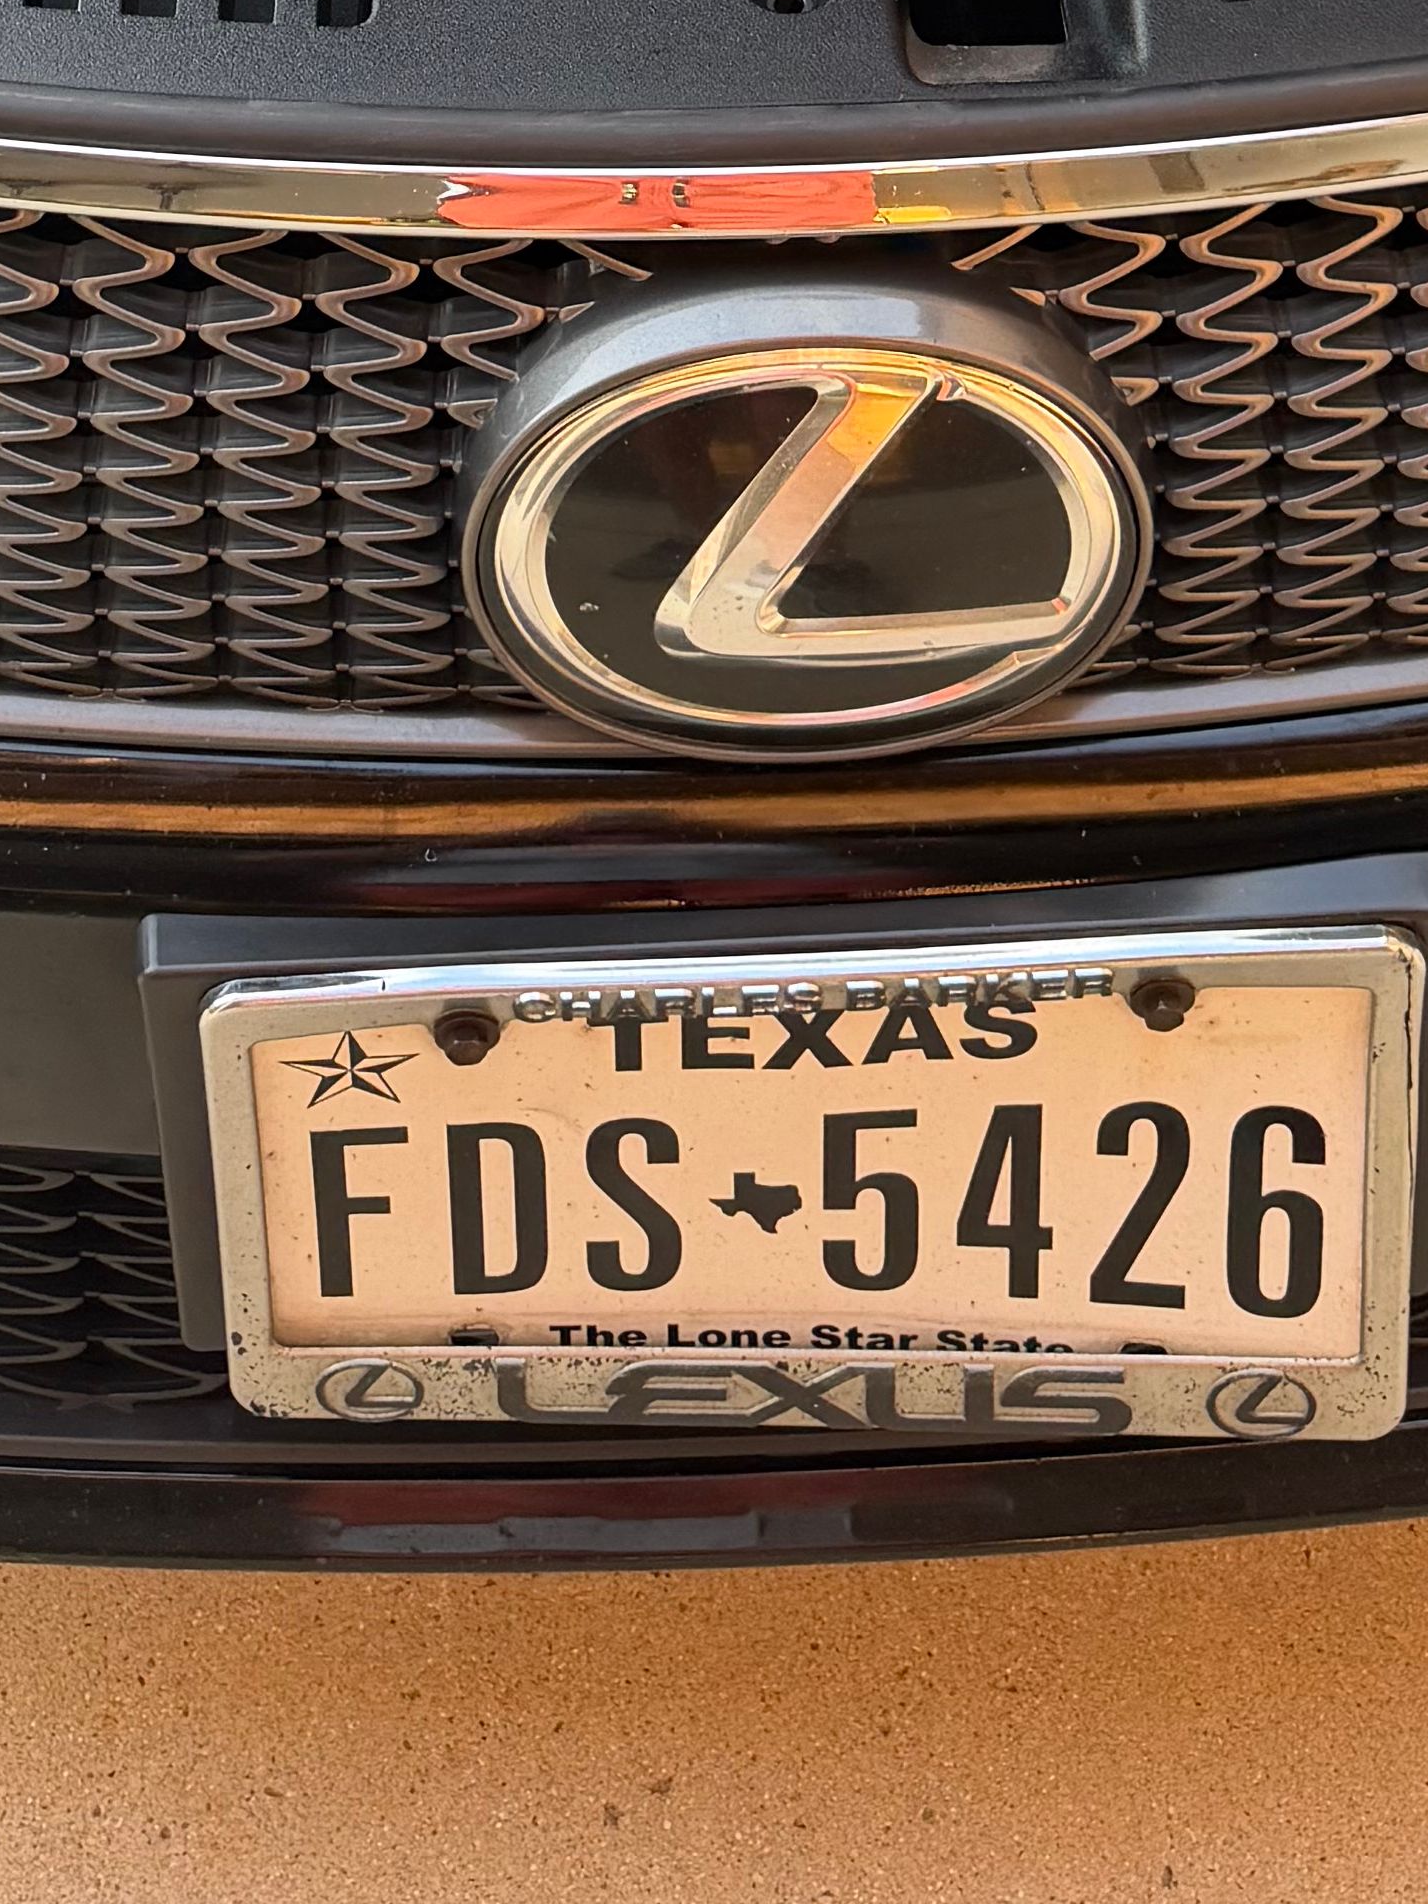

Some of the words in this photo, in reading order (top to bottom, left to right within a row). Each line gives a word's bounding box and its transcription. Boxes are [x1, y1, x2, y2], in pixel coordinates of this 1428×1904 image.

[513, 981, 822, 1023] CHARLES
[845, 967, 1114, 1011] BARKER
[586, 998, 1039, 1072] TEXAS
[310, 1117, 683, 1298] FDS
[821, 1101, 1327, 1318] 5426
[549, 1325, 647, 1347] The
[668, 1323, 792, 1348] Lone
[810, 1325, 918, 1351] Star
[496, 1357, 1133, 1435] LEXUS
